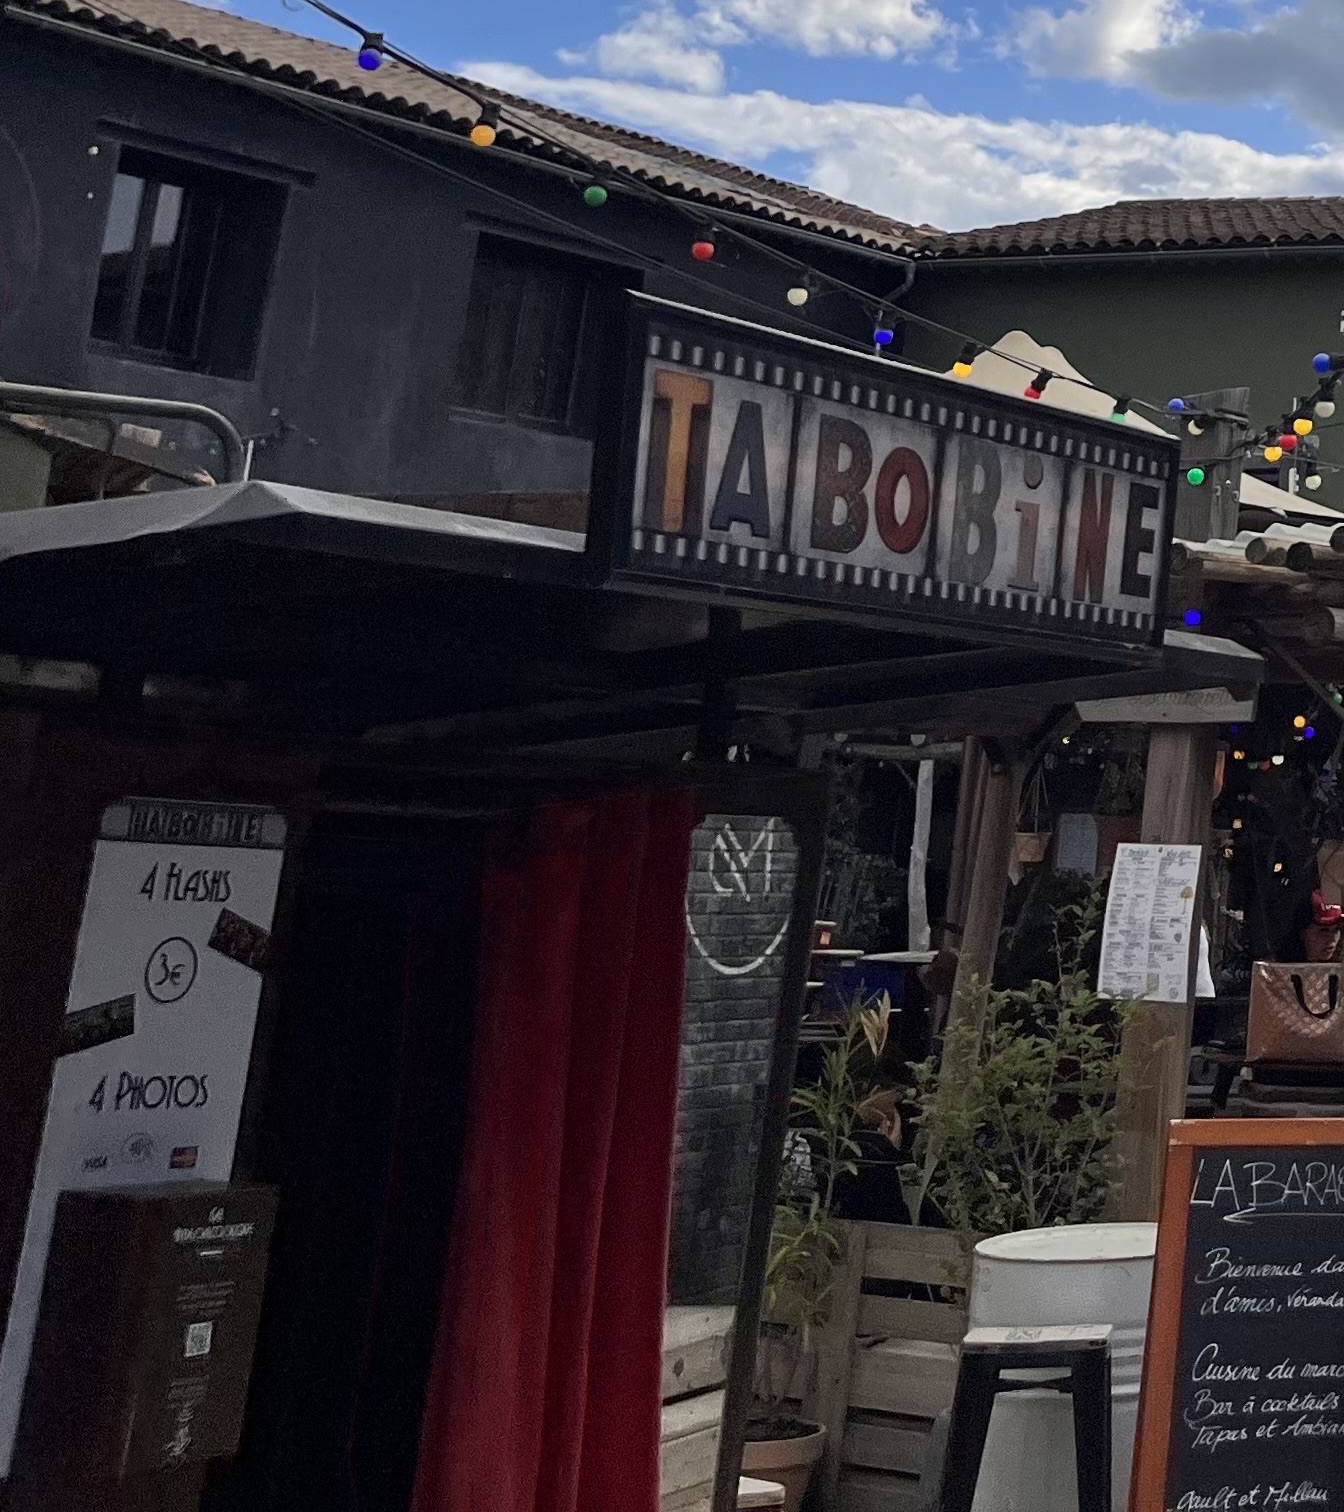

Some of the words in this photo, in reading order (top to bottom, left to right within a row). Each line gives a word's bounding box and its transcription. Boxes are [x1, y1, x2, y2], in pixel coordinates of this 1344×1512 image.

[140, 861, 159, 901] 4
[89, 1074, 108, 1112] 4
[114, 1070, 209, 1110] PHOTOS
[1190, 1158, 1241, 1211] LA
[1195, 1247, 1303, 1284] Bienvenue
[1191, 1343, 1260, 1382] Cuisine
[1266, 1357, 1296, 1380] du
[1184, 1389, 1236, 1425] Bar
[1261, 1392, 1340, 1413] cocktails
[1191, 1425, 1248, 1453] Tapas
[1256, 1418, 1278, 1439] et
[1238, 1484, 1261, 1507] et
